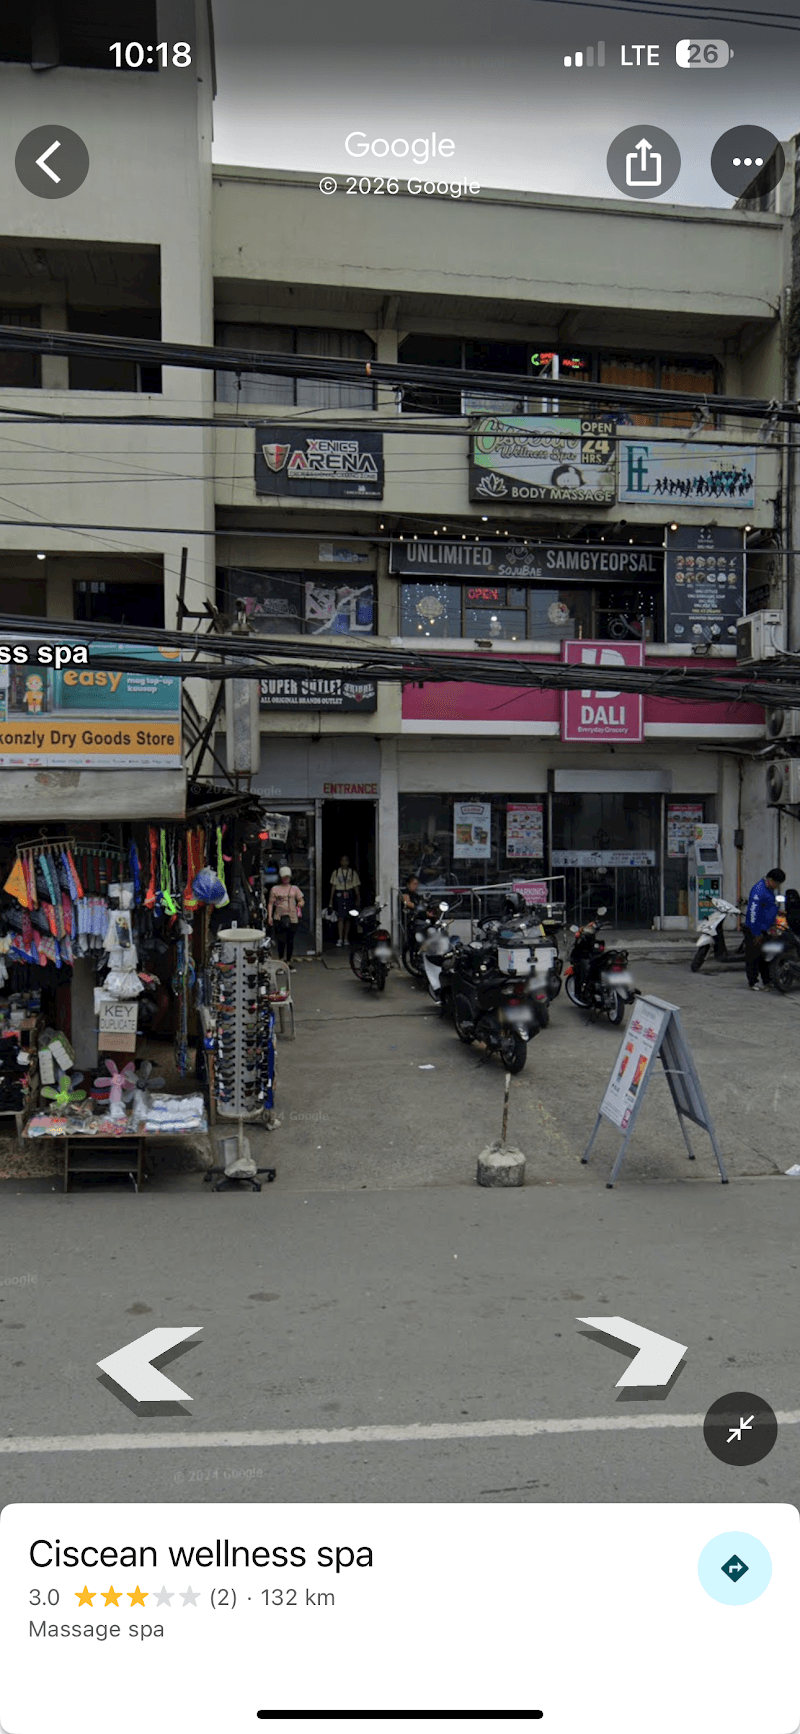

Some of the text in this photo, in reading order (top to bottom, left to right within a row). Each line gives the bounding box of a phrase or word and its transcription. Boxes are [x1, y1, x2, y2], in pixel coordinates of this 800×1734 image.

[581, 421, 612, 433] OPEN
[306, 438, 359, 453] XENICS
[582, 432, 610, 455] 24
[287, 450, 378, 473] ARENA
[511, 486, 613, 502] BODY MASSAGE
[406, 542, 657, 573] UNLIMITED SAMGYEOPSAL
[467, 587, 498, 601] OPEN
[63, 670, 123, 692] easy
[260, 679, 298, 695] SUPER
[299, 697, 321, 705] BRANDS
[321, 697, 343, 705] OUTLET
[581, 705, 626, 726] DALI
[578, 726, 604, 734] Everyday
[51, 730, 77, 749] Dry
[82, 730, 131, 746] Goods
[136, 730, 175, 746] Store
[323, 782, 378, 795] ENTRANCE
[104, 1005, 134, 1018] KEY
[100, 1018, 136, 1031] DUPLICATE
